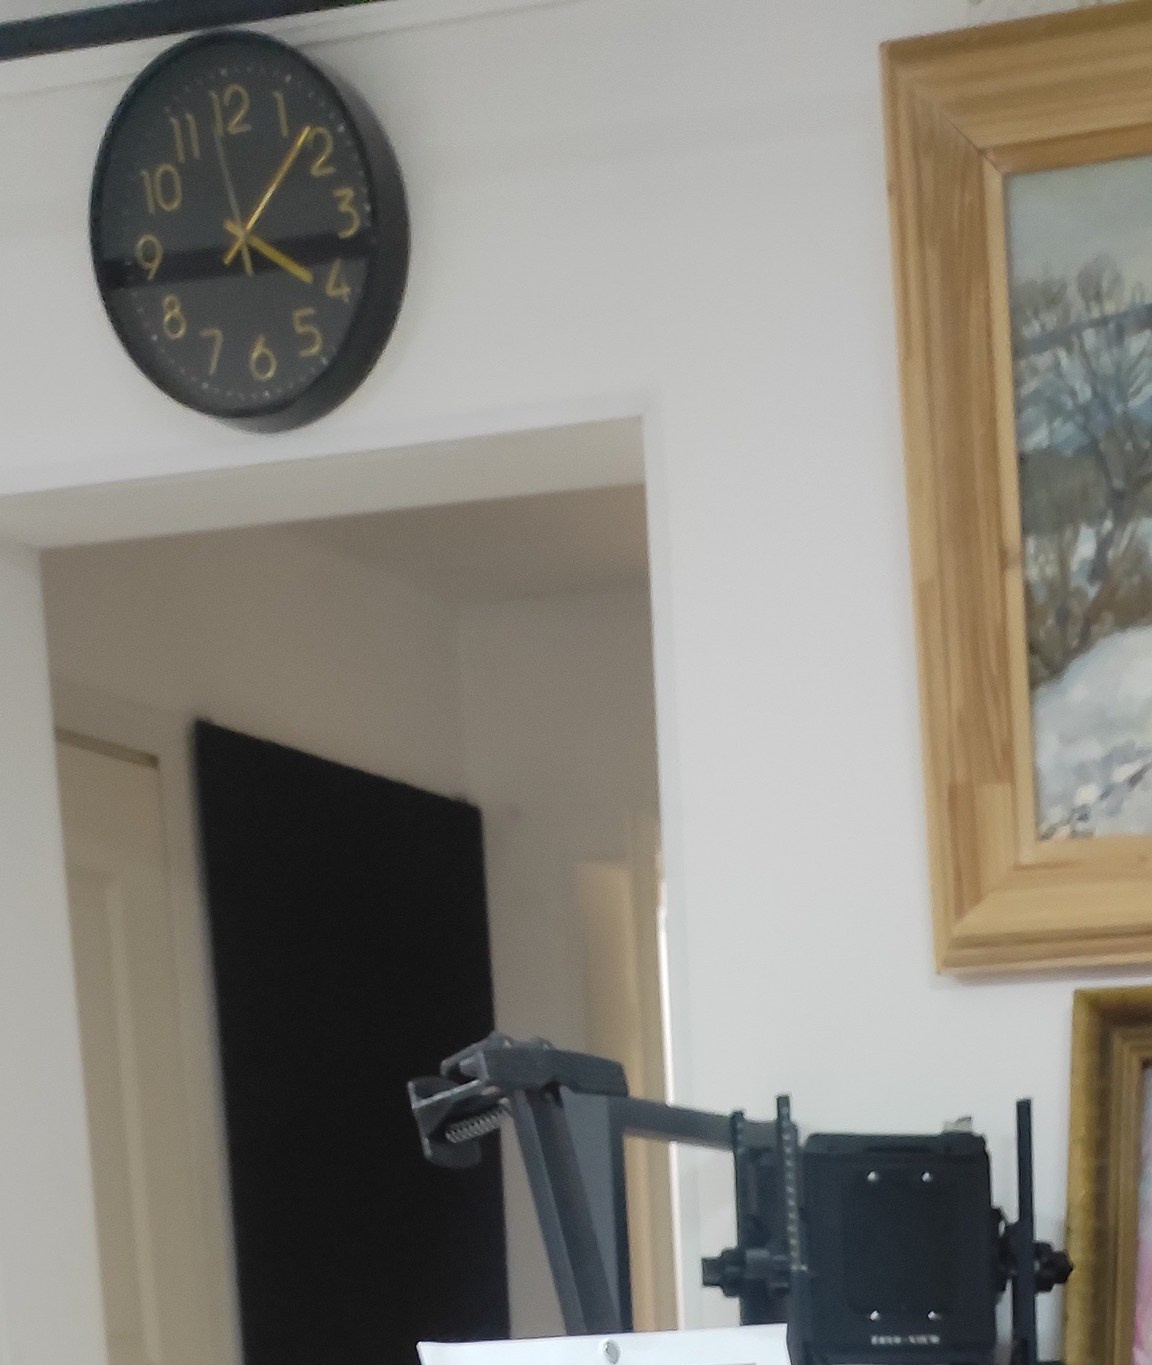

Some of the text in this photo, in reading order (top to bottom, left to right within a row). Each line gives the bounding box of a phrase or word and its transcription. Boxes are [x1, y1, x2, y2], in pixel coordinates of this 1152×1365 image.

[210, 83, 252, 137] 12
[272, 90, 289, 138] 1
[168, 113, 200, 164] 11
[307, 126, 336, 177] 2
[140, 163, 183, 215] 10
[333, 187, 361, 239] 3
[135, 234, 163, 281] 9
[325, 259, 352, 303] 4
[162, 294, 187, 340] 8
[292, 307, 323, 357] 5
[200, 327, 223, 376] 7
[249, 335, 278, 381] 6
